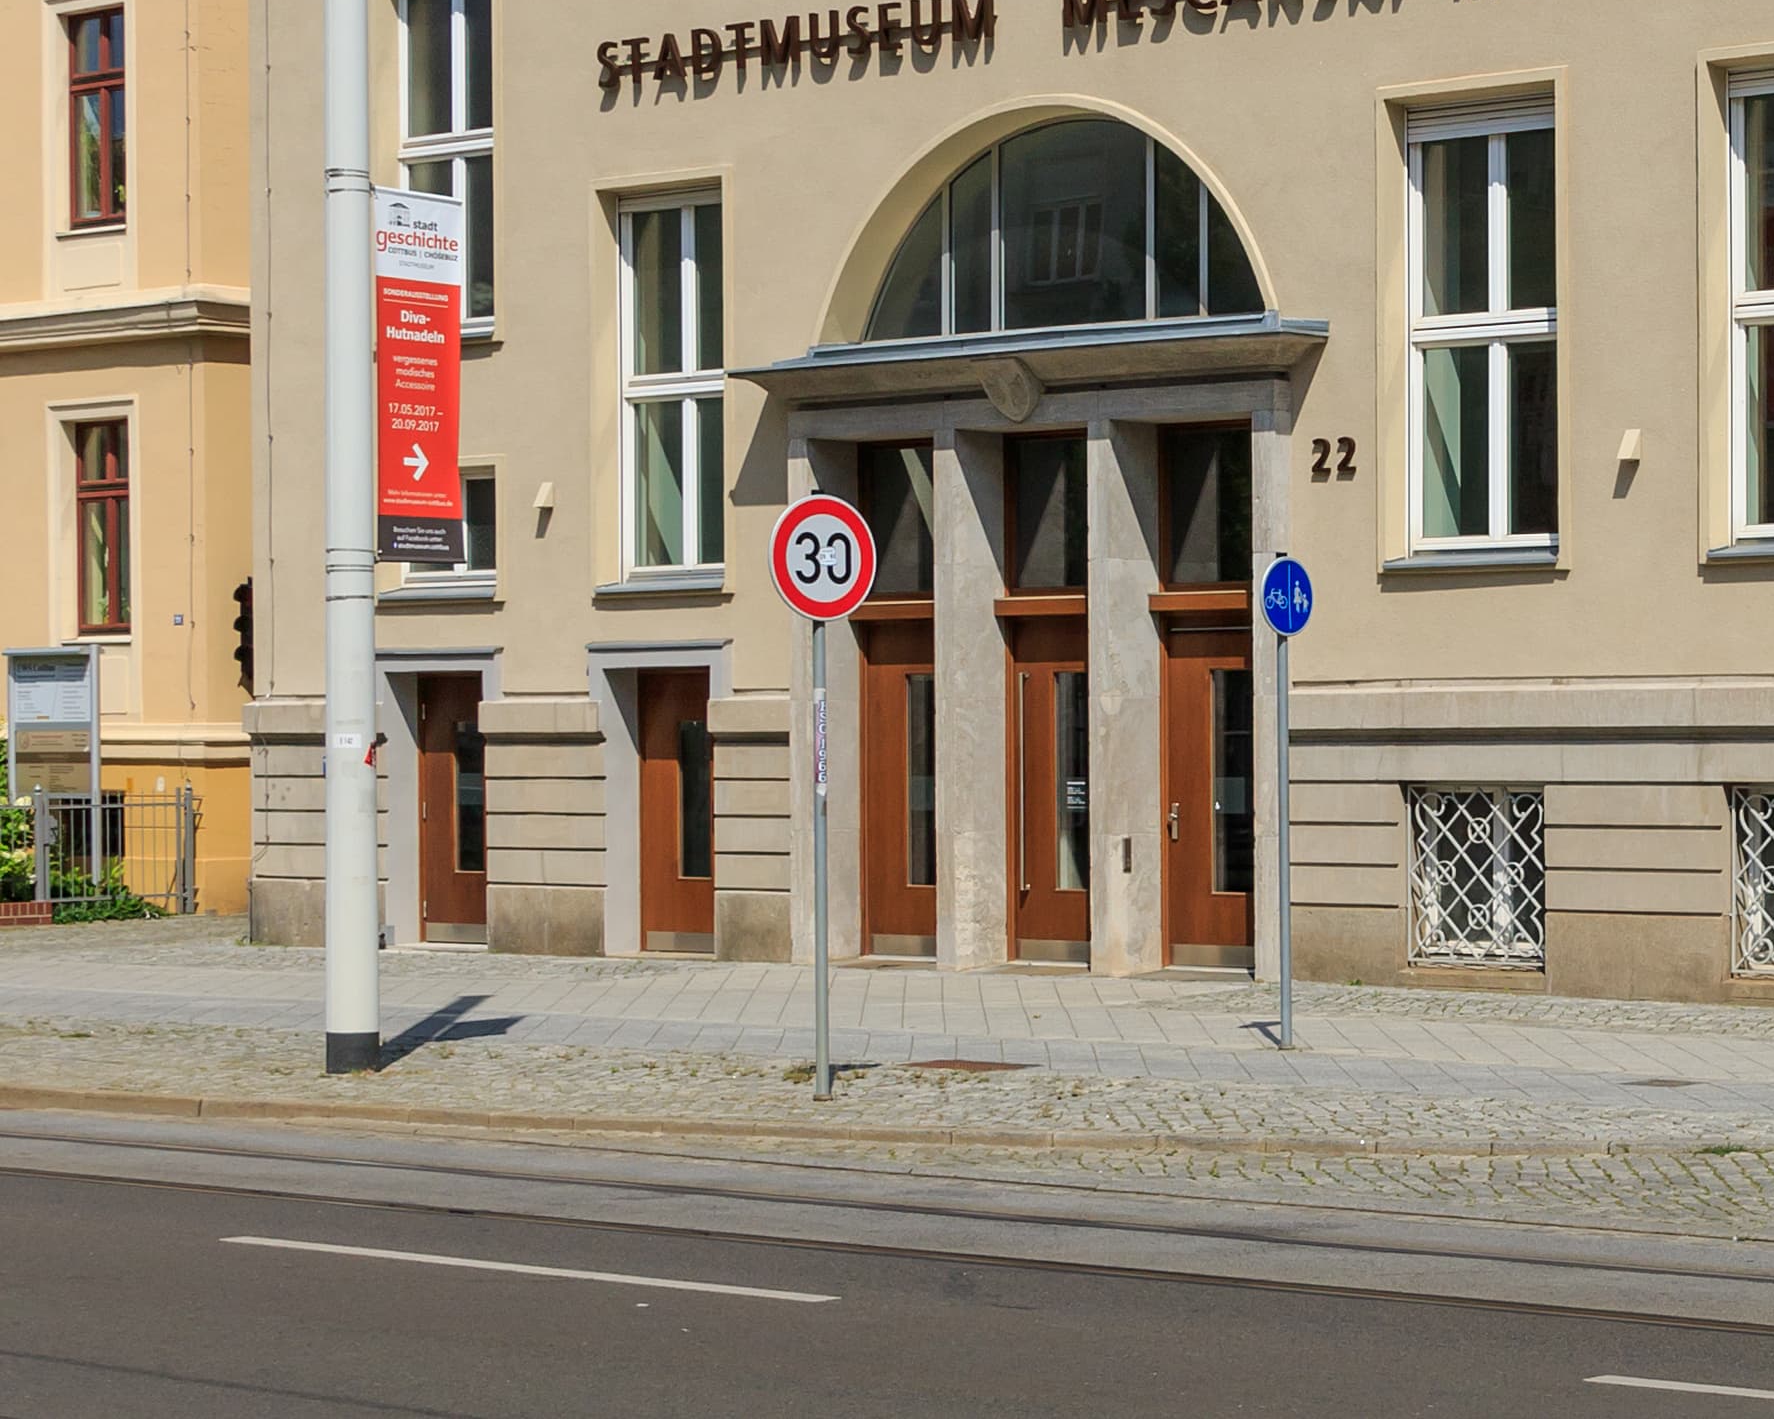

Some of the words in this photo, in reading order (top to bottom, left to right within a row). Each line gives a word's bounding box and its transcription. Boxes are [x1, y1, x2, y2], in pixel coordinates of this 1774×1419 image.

[413, 220, 438, 232] stadt
[376, 230, 458, 252] geschichte
[400, 310, 431, 325] Diva-
[386, 325, 445, 344] Hutnadeln
[388, 402, 436, 417] 17.05.2017
[391, 418, 440, 432] 20.09.2017
[1312, 437, 1356, 473] 22
[795, 531, 852, 585] 30
